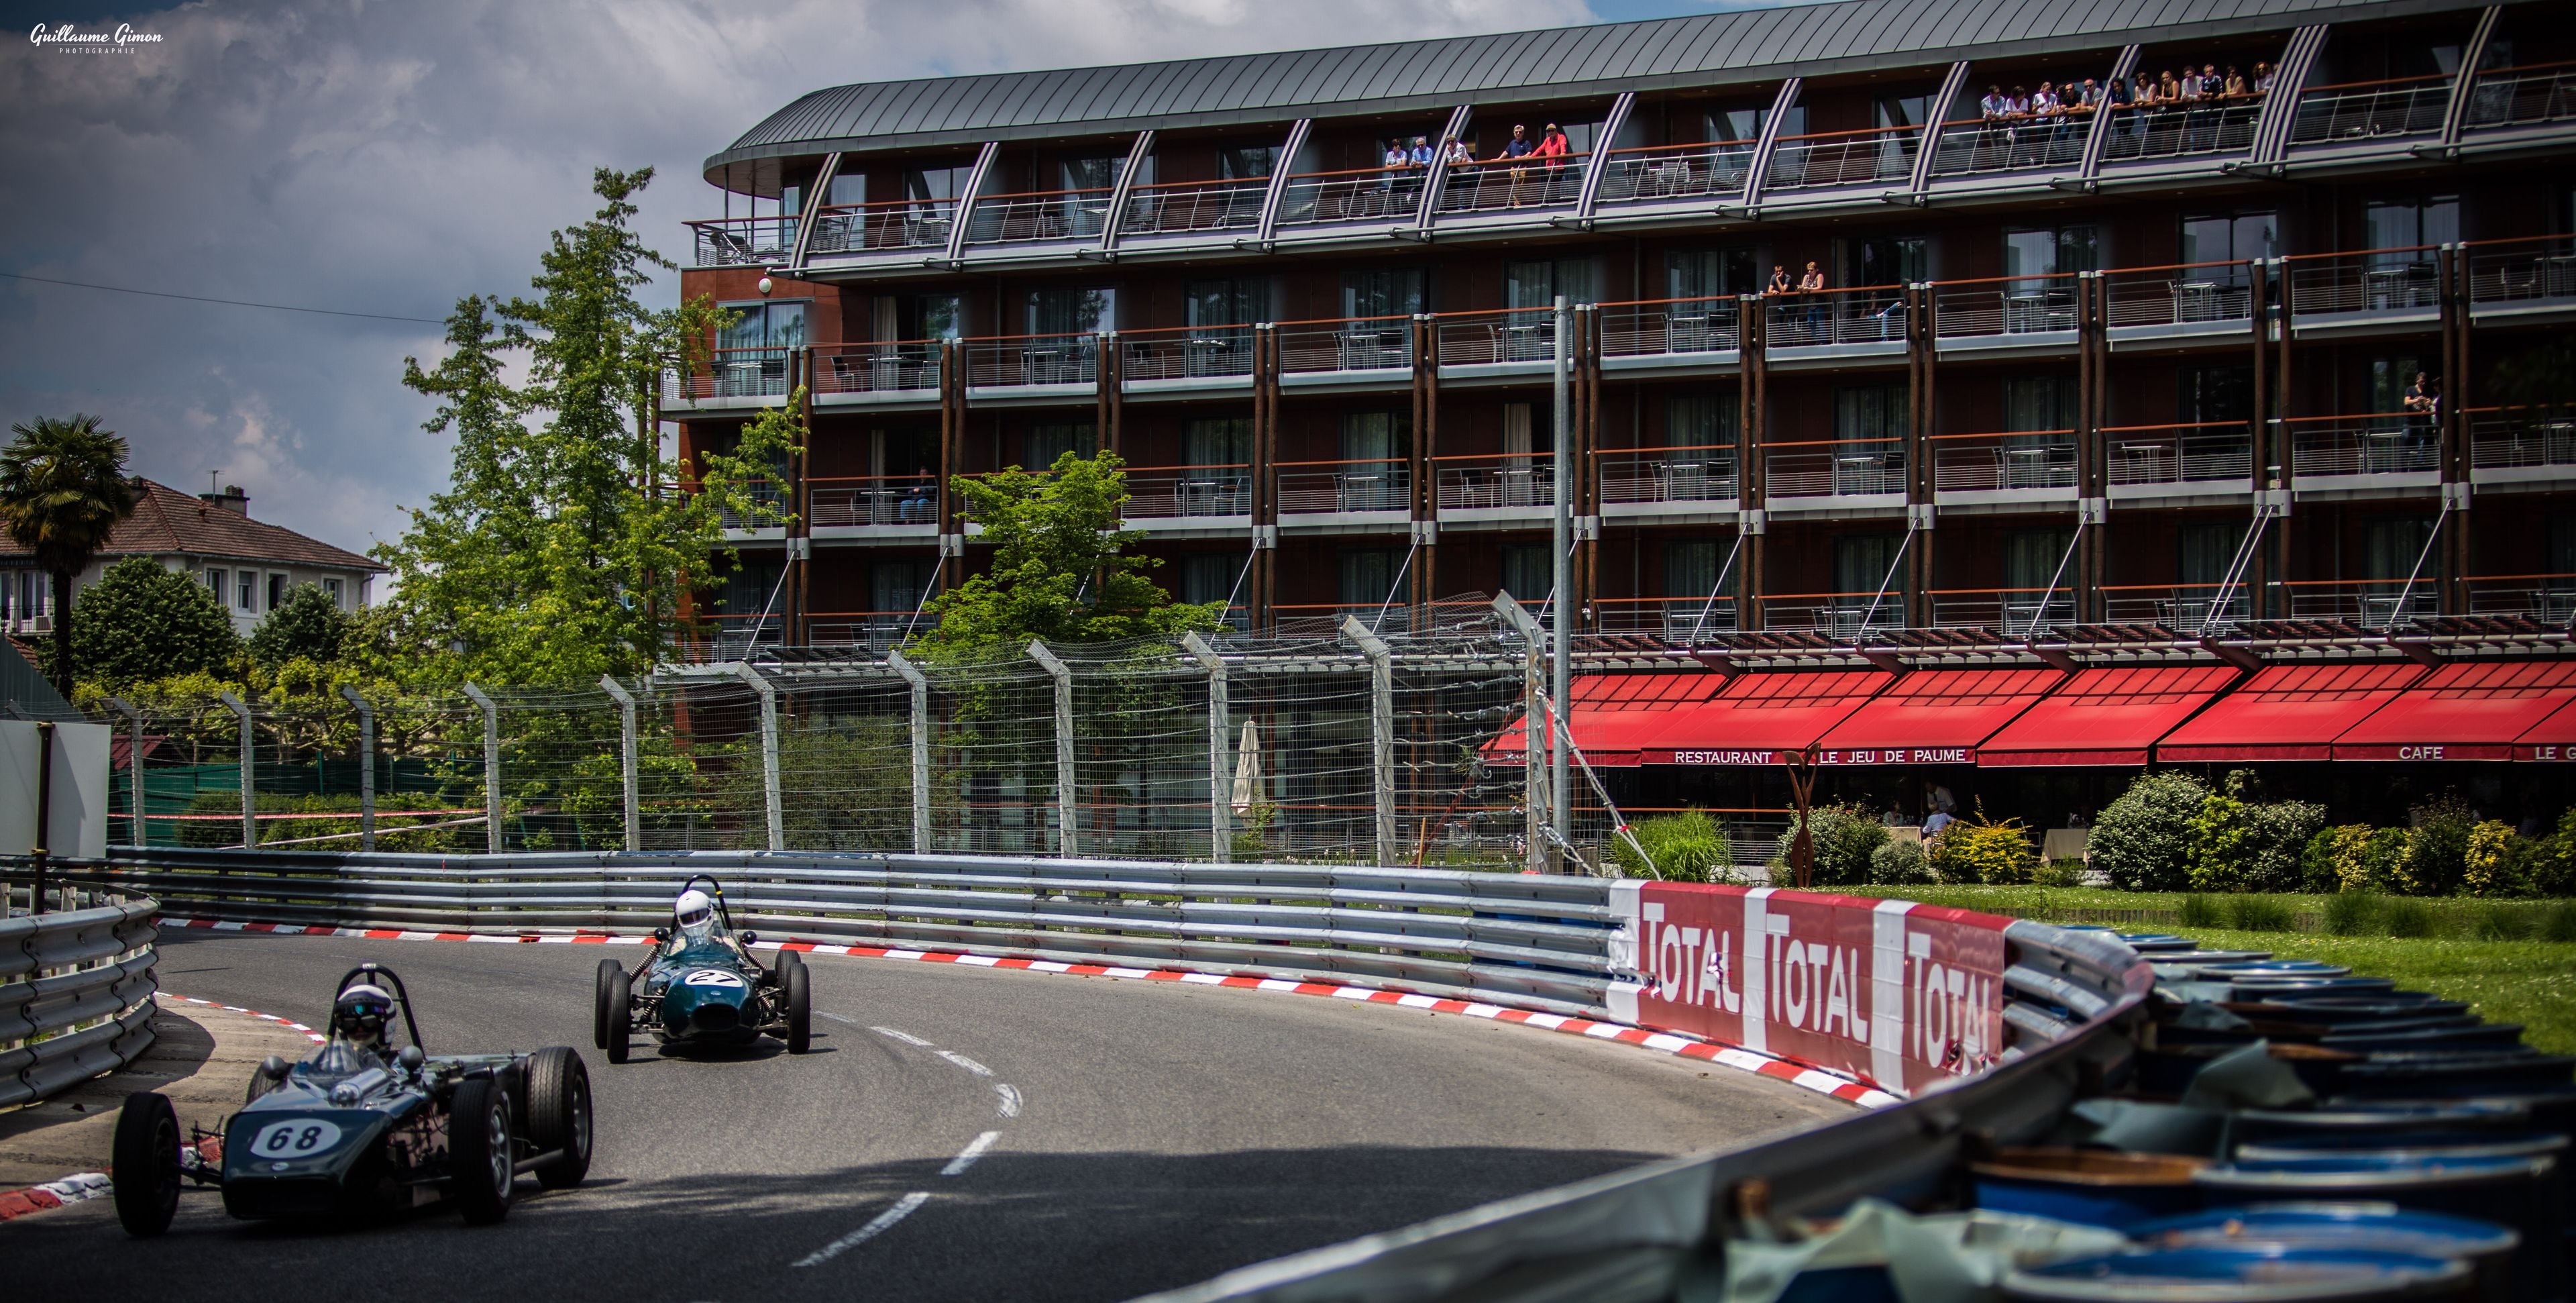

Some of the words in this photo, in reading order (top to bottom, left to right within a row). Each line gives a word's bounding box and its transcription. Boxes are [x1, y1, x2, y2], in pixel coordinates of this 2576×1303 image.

[1675, 751, 1772, 764] RESTAURANT
[1819, 751, 1837, 764] LE
[1847, 751, 1874, 763] JEU
[1884, 750, 1904, 762] DE
[1915, 749, 1965, 762] PAUME
[2399, 746, 2443, 760] CAFE
[2535, 746, 2557, 760] LE
[690, 972, 738, 983] 27
[1766, 913, 1869, 1043] TOTAL
[266, 1126, 322, 1151] 68
